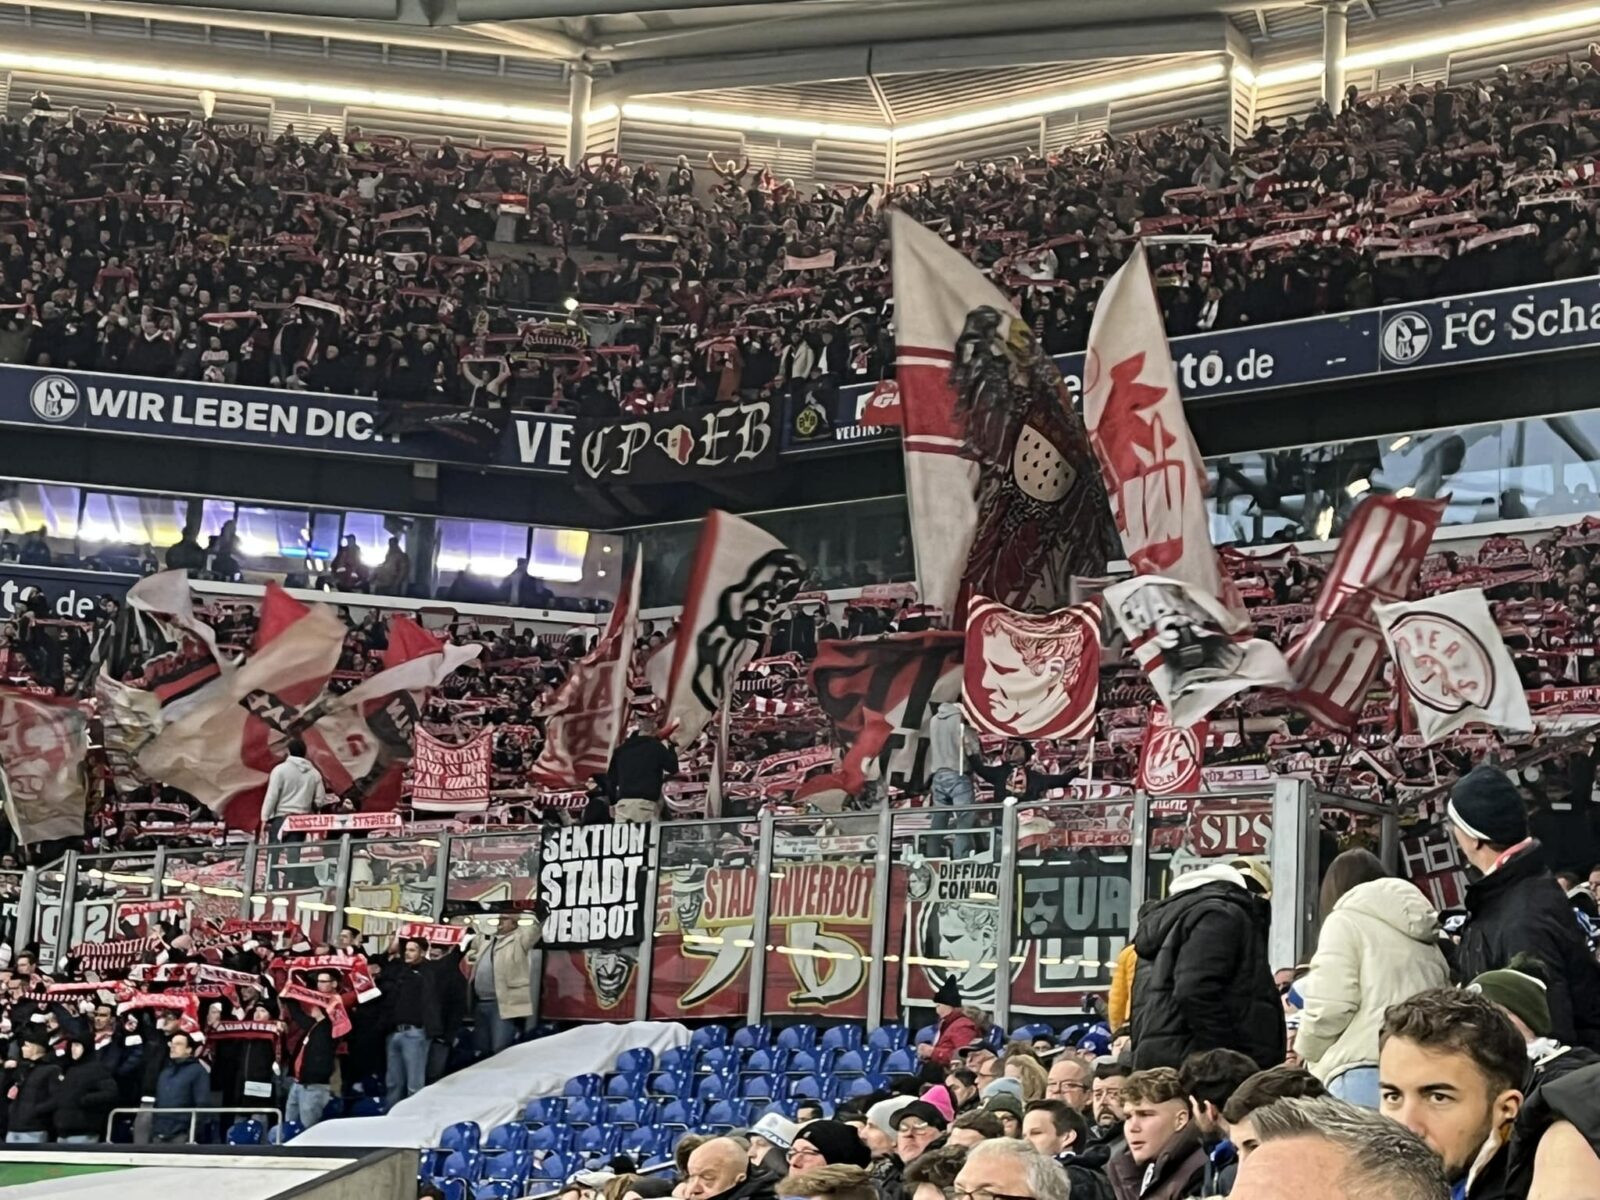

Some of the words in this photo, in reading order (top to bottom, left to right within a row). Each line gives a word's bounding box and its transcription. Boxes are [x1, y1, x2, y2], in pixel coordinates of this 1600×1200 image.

[1441, 308, 1496, 350] FC
[1172, 349, 1274, 389] to.de
[86, 386, 164, 422] WIR
[172, 395, 299, 434] LEBEN
[306, 408, 400, 443] DIC
[543, 823, 646, 862] SEKTION
[1200, 813, 1273, 850] SPS
[541, 856, 644, 908] STADT
[542, 902, 639, 943] VERBOT
